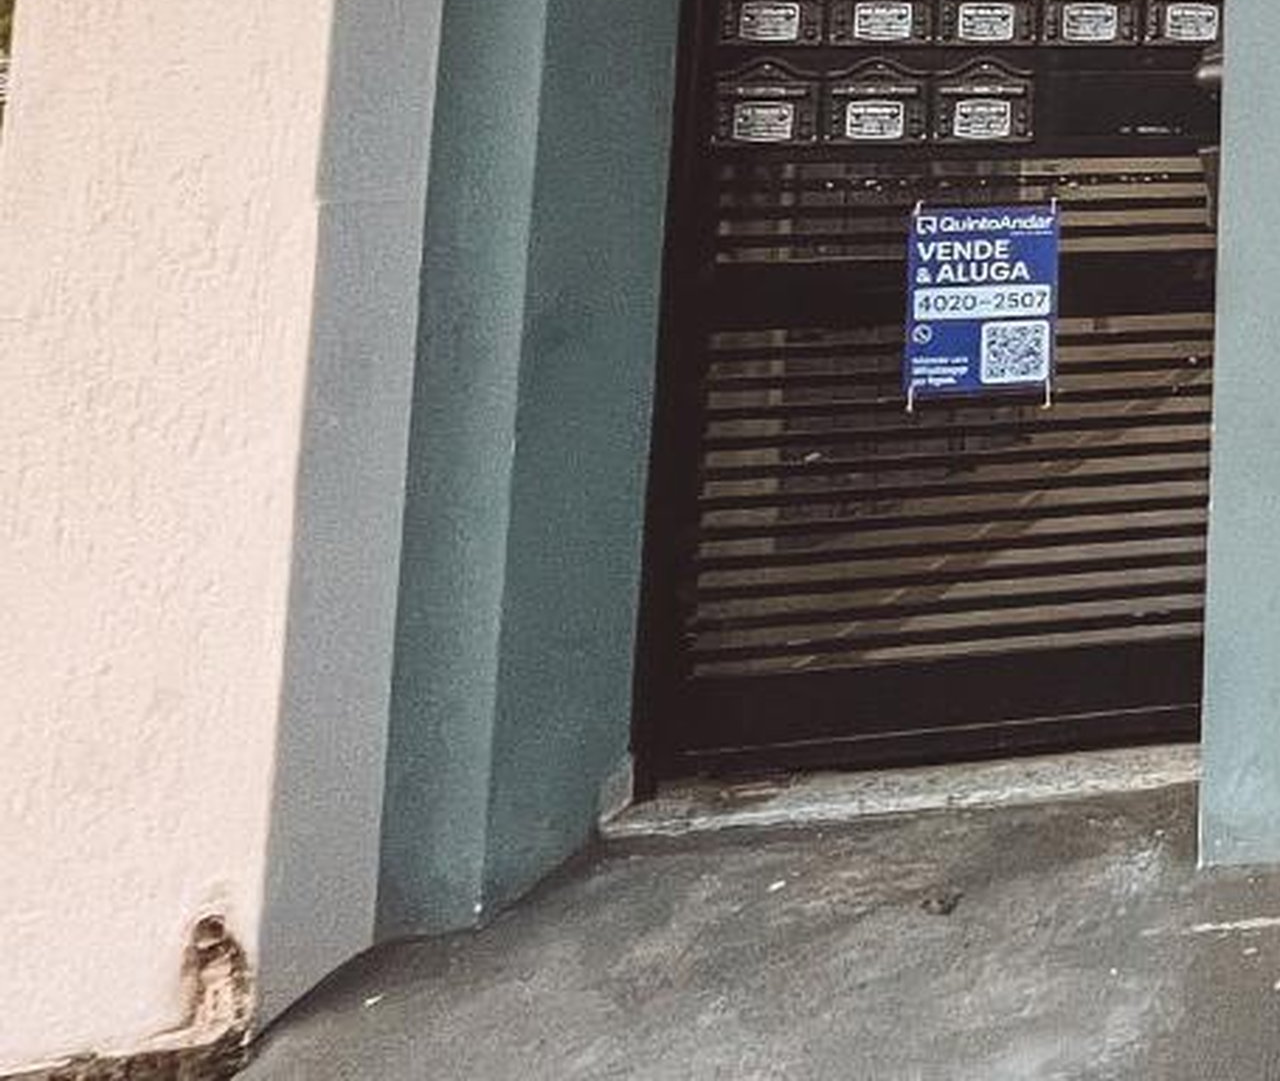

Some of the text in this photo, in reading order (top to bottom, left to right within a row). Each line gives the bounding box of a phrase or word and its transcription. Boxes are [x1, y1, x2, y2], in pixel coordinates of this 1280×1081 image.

[938, 215, 1055, 233] QuintoAndar
[916, 239, 1012, 262] VENDE
[915, 261, 1031, 284] & ALUGA
[917, 290, 1048, 313] 4020-2507
